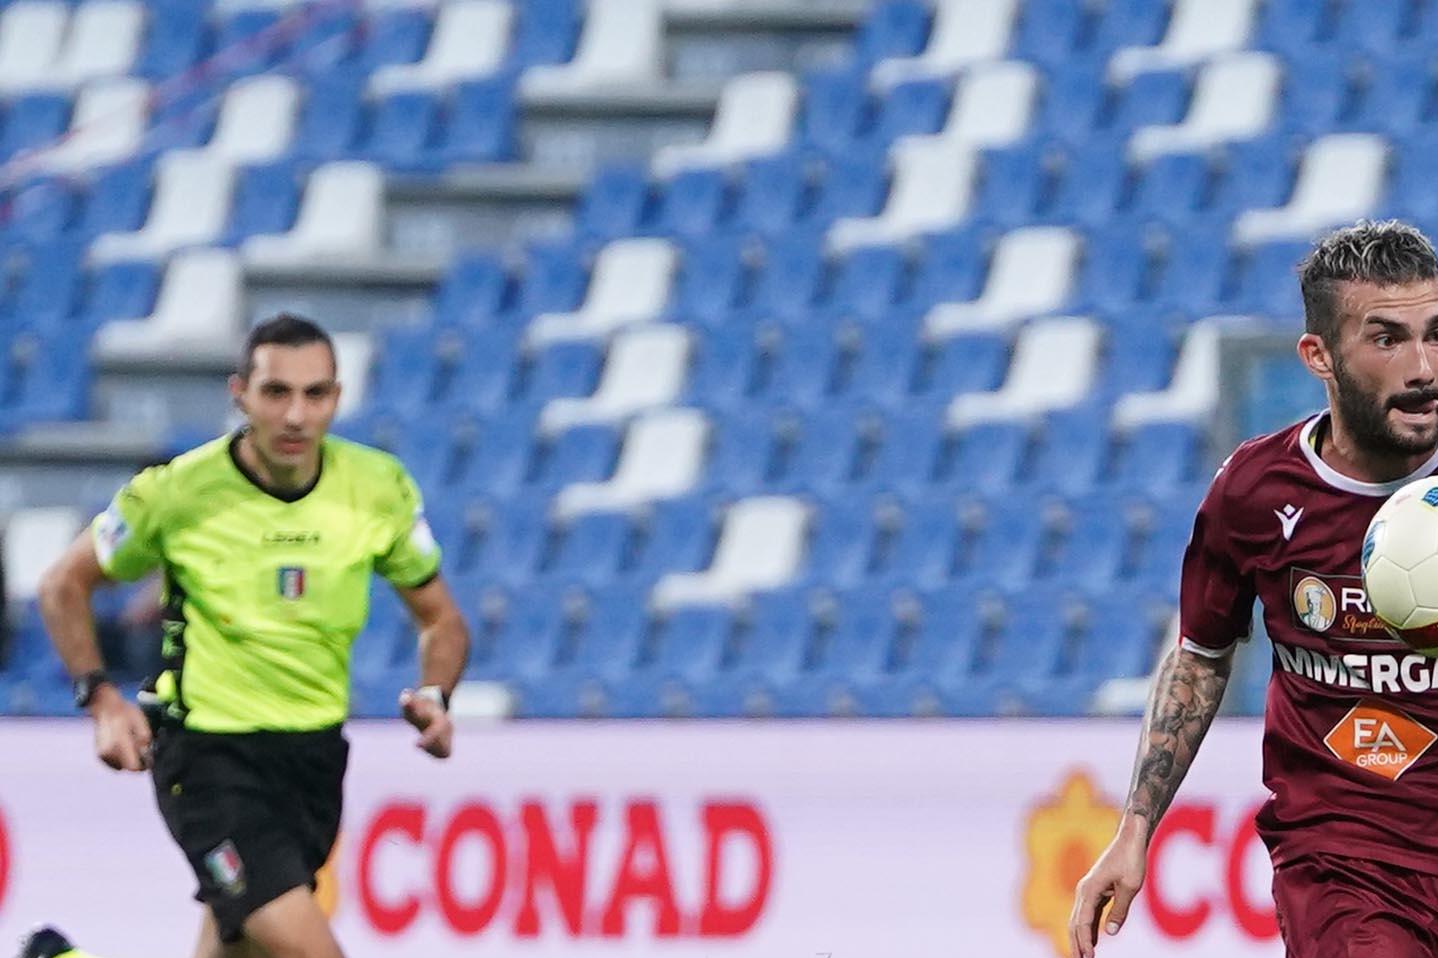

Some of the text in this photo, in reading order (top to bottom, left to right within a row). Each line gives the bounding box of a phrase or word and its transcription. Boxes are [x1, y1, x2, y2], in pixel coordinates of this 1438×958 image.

[1353, 718, 1406, 752] EA
[1356, 752, 1408, 767] GROUP
[357, 801, 773, 938] CONAD
